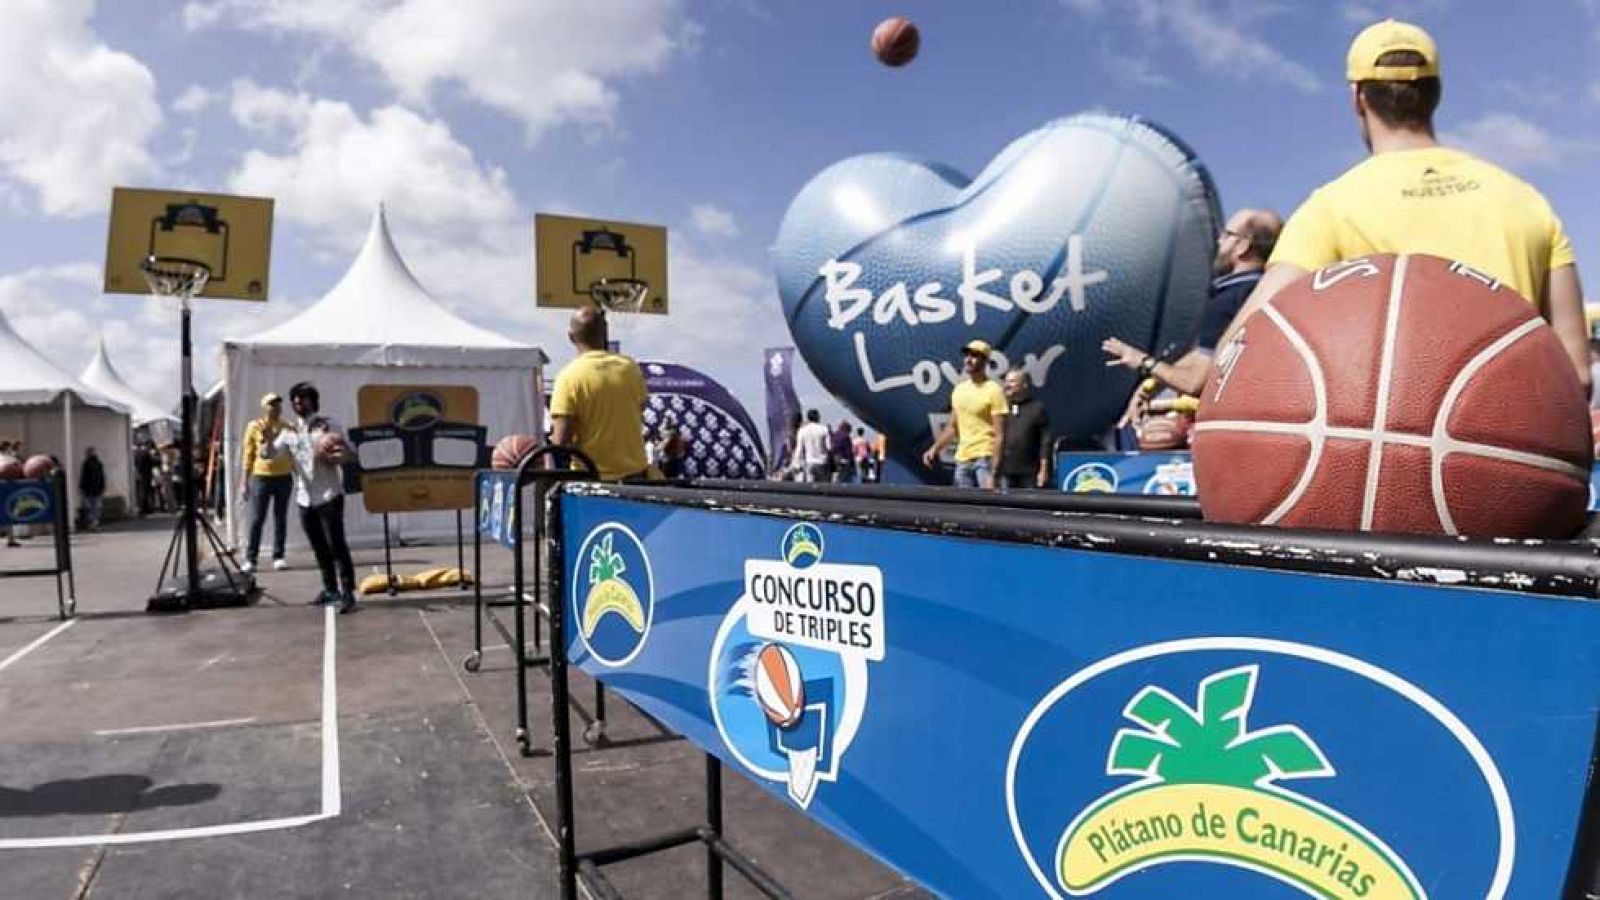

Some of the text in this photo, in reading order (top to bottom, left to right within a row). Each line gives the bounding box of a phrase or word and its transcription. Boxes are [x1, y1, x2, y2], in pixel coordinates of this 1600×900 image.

[818, 234, 1107, 329] Basket
[751, 574, 875, 616] CONCURSO
[775, 611, 872, 648] DE TRIPLES
[1087, 802, 1377, 897] Plátano de Canarias
